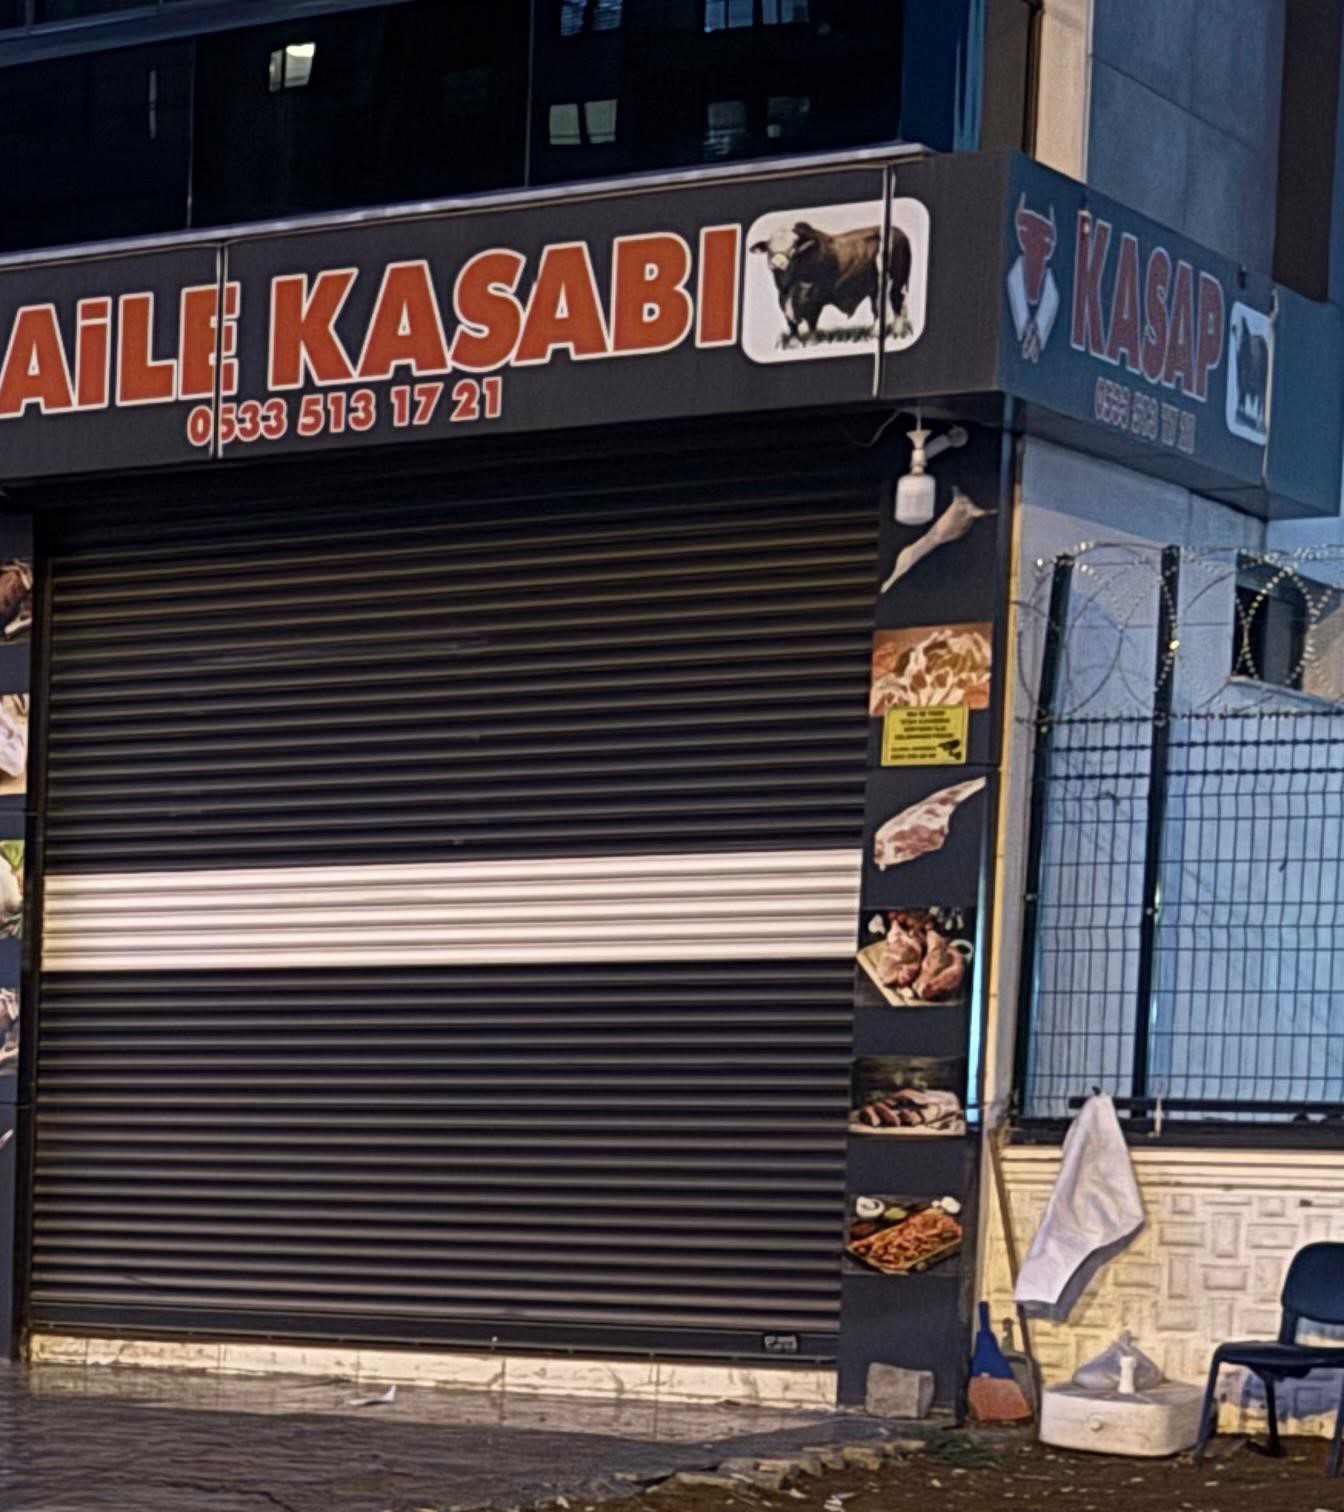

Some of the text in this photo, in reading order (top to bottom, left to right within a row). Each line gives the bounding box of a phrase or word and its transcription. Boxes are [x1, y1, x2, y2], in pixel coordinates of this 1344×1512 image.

[267, 223, 742, 391] KASABI
[1070, 209, 1225, 403] KASAP
[187, 376, 502, 447] 0533 513 17 21
